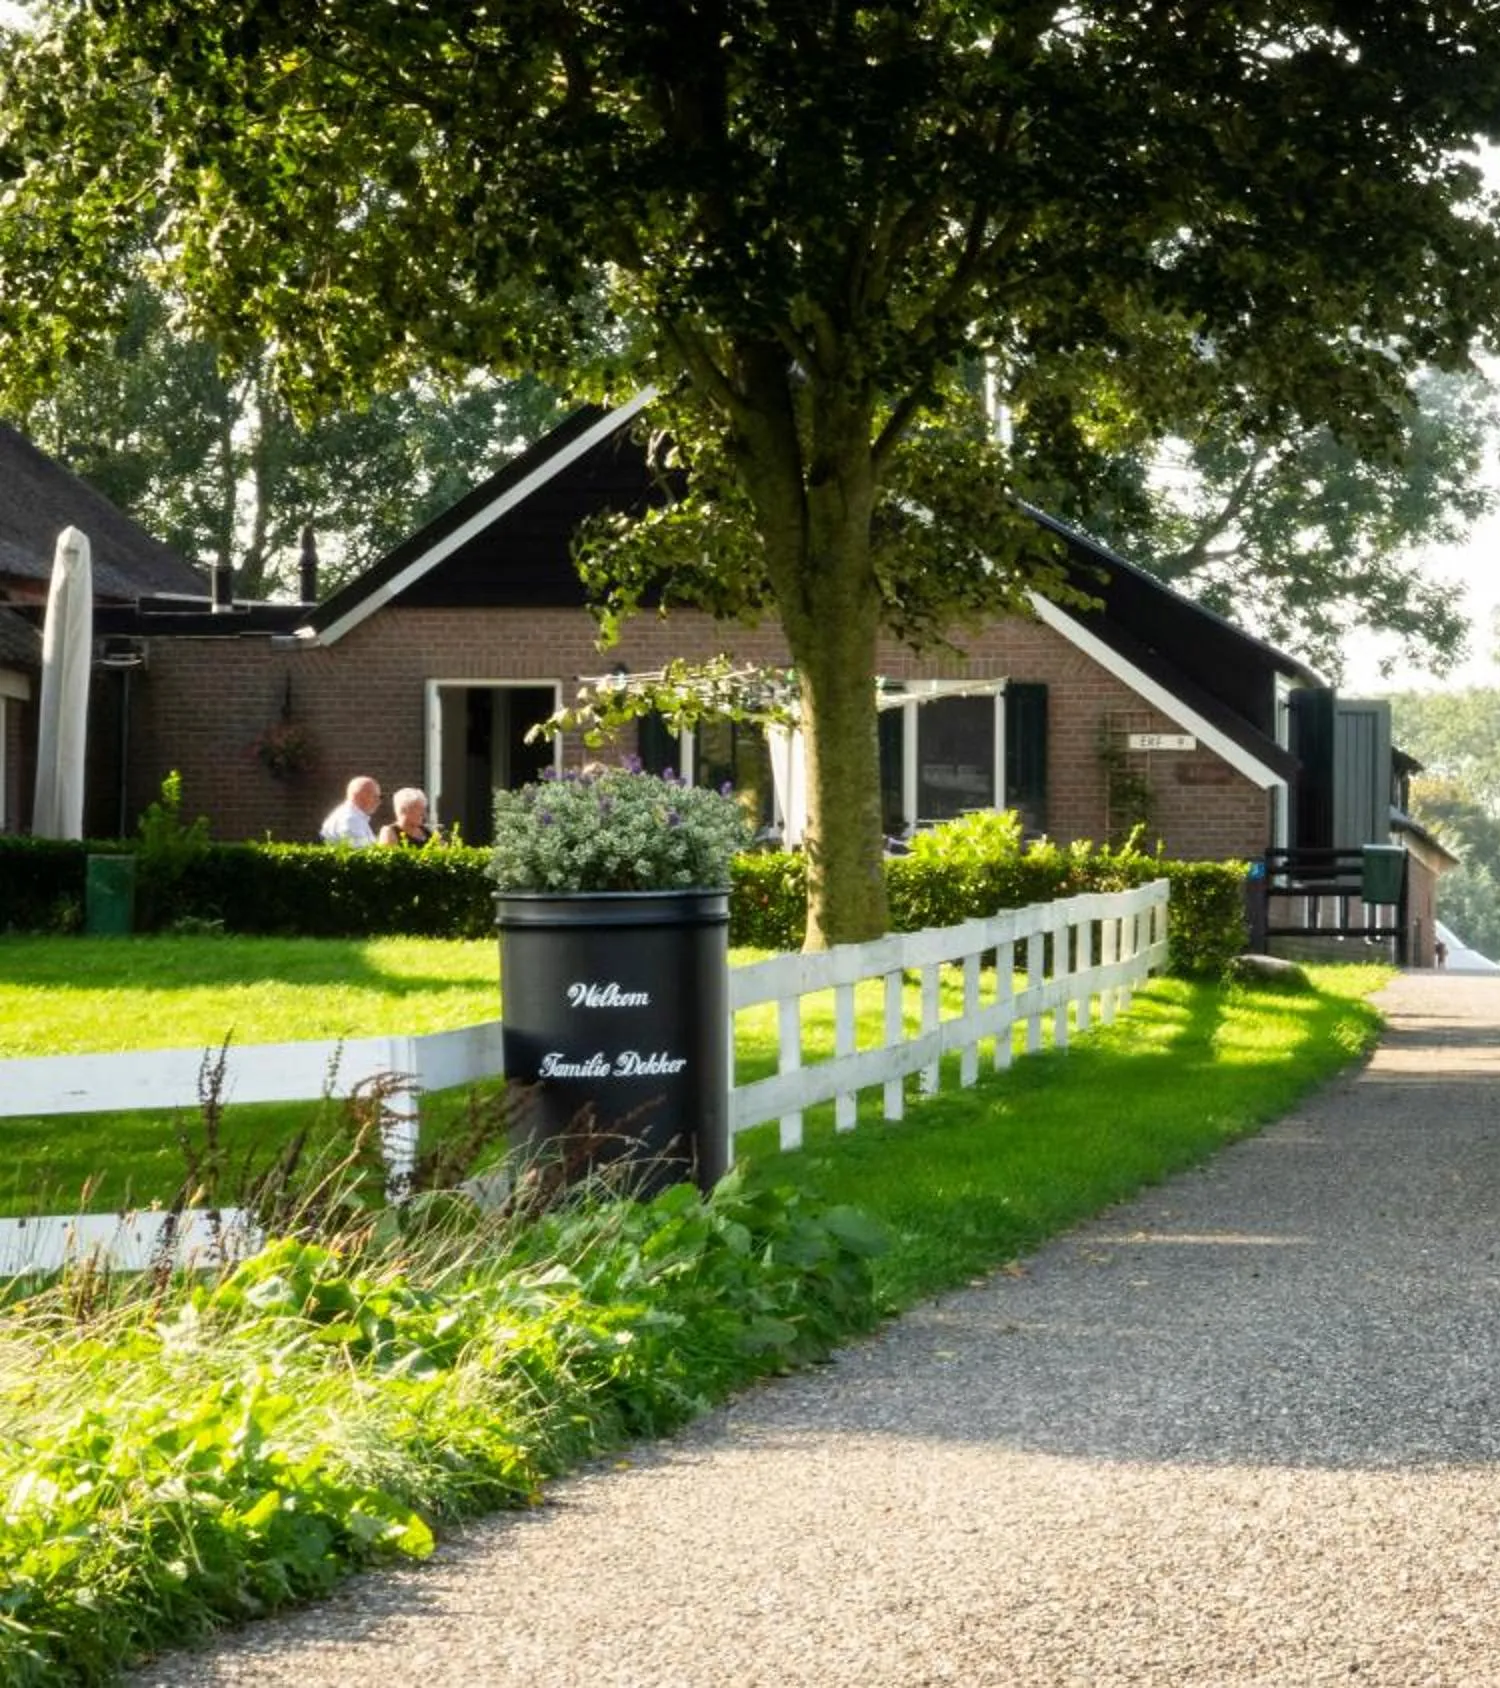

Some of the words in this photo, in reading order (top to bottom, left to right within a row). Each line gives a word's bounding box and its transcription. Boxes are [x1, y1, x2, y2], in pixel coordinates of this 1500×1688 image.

[567, 982, 650, 1008] Welkom
[538, 1052, 612, 1077] Familie
[613, 1050, 687, 1077] Dekker
